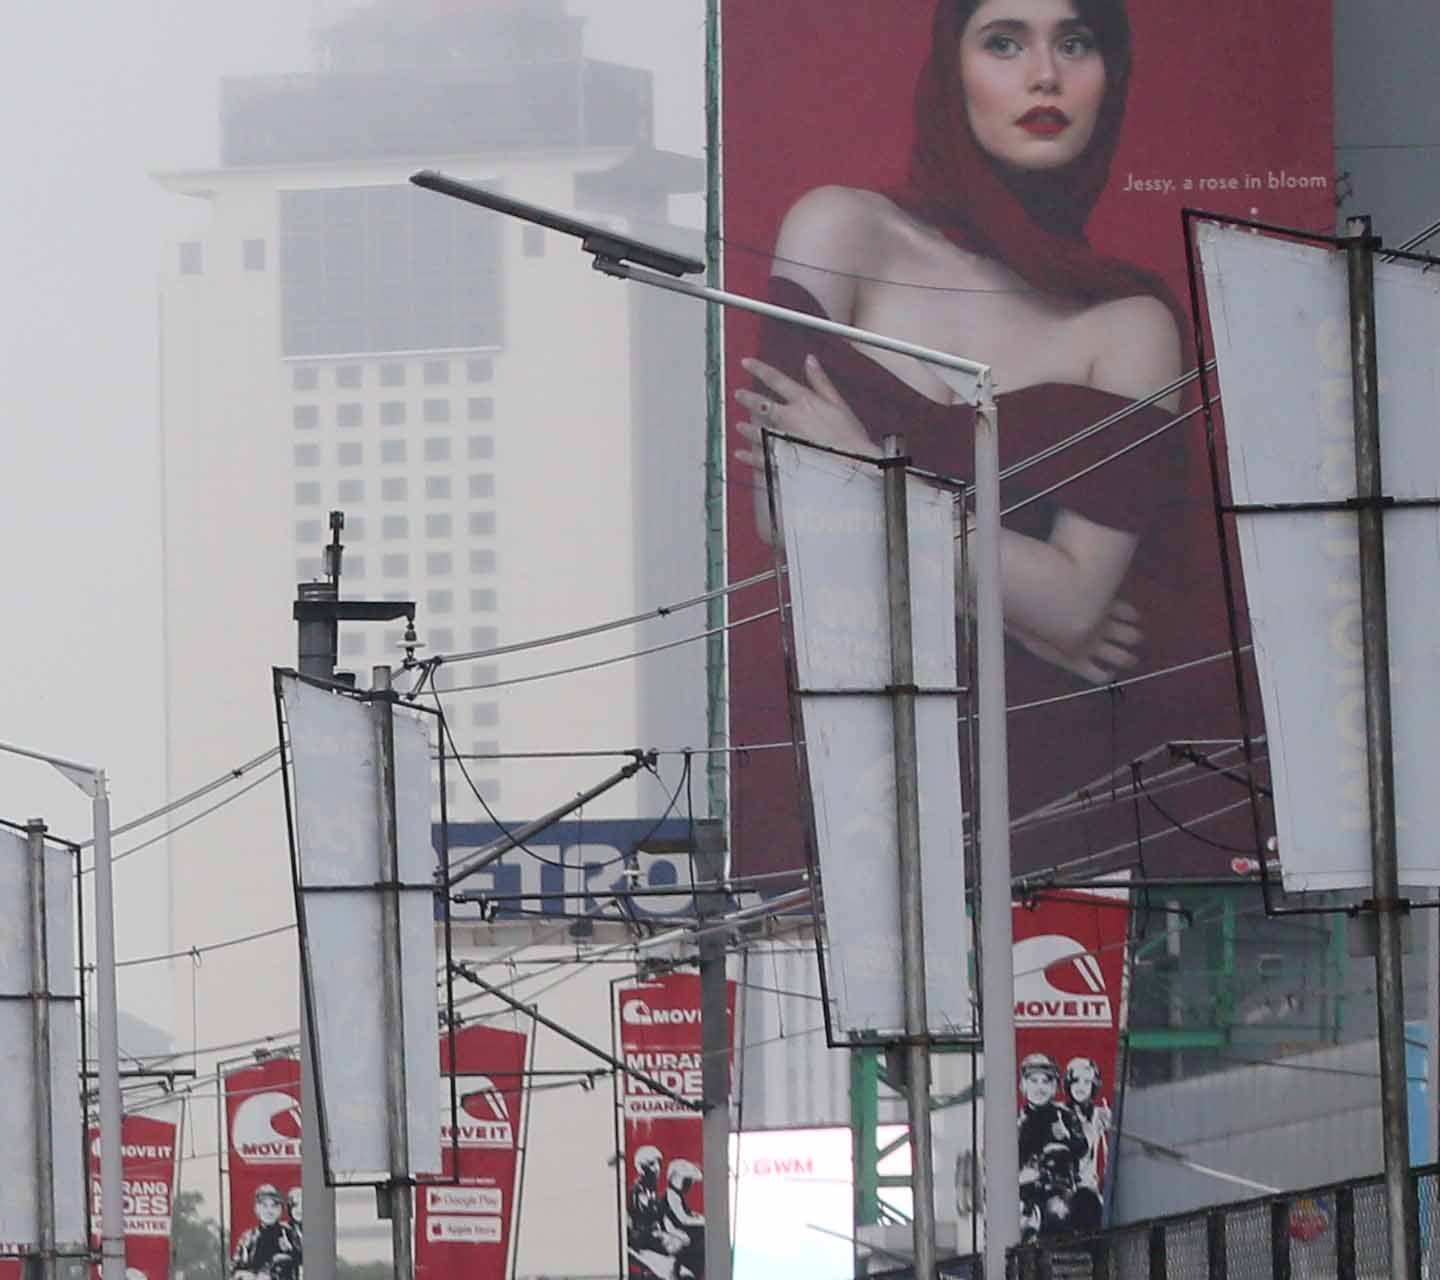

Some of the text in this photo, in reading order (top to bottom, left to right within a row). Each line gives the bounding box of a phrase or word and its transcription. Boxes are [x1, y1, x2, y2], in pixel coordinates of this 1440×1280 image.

[1183, 179, 1193, 190] a
[1199, 178, 1238, 190] rose
[1245, 173, 1262, 189] in
[1268, 171, 1328, 189] bloom
[448, 843, 694, 918] ETRO
[652, 1008, 702, 1024] MOV
[627, 1071, 703, 1094] RIDE
[753, 1159, 814, 1175] GWM
